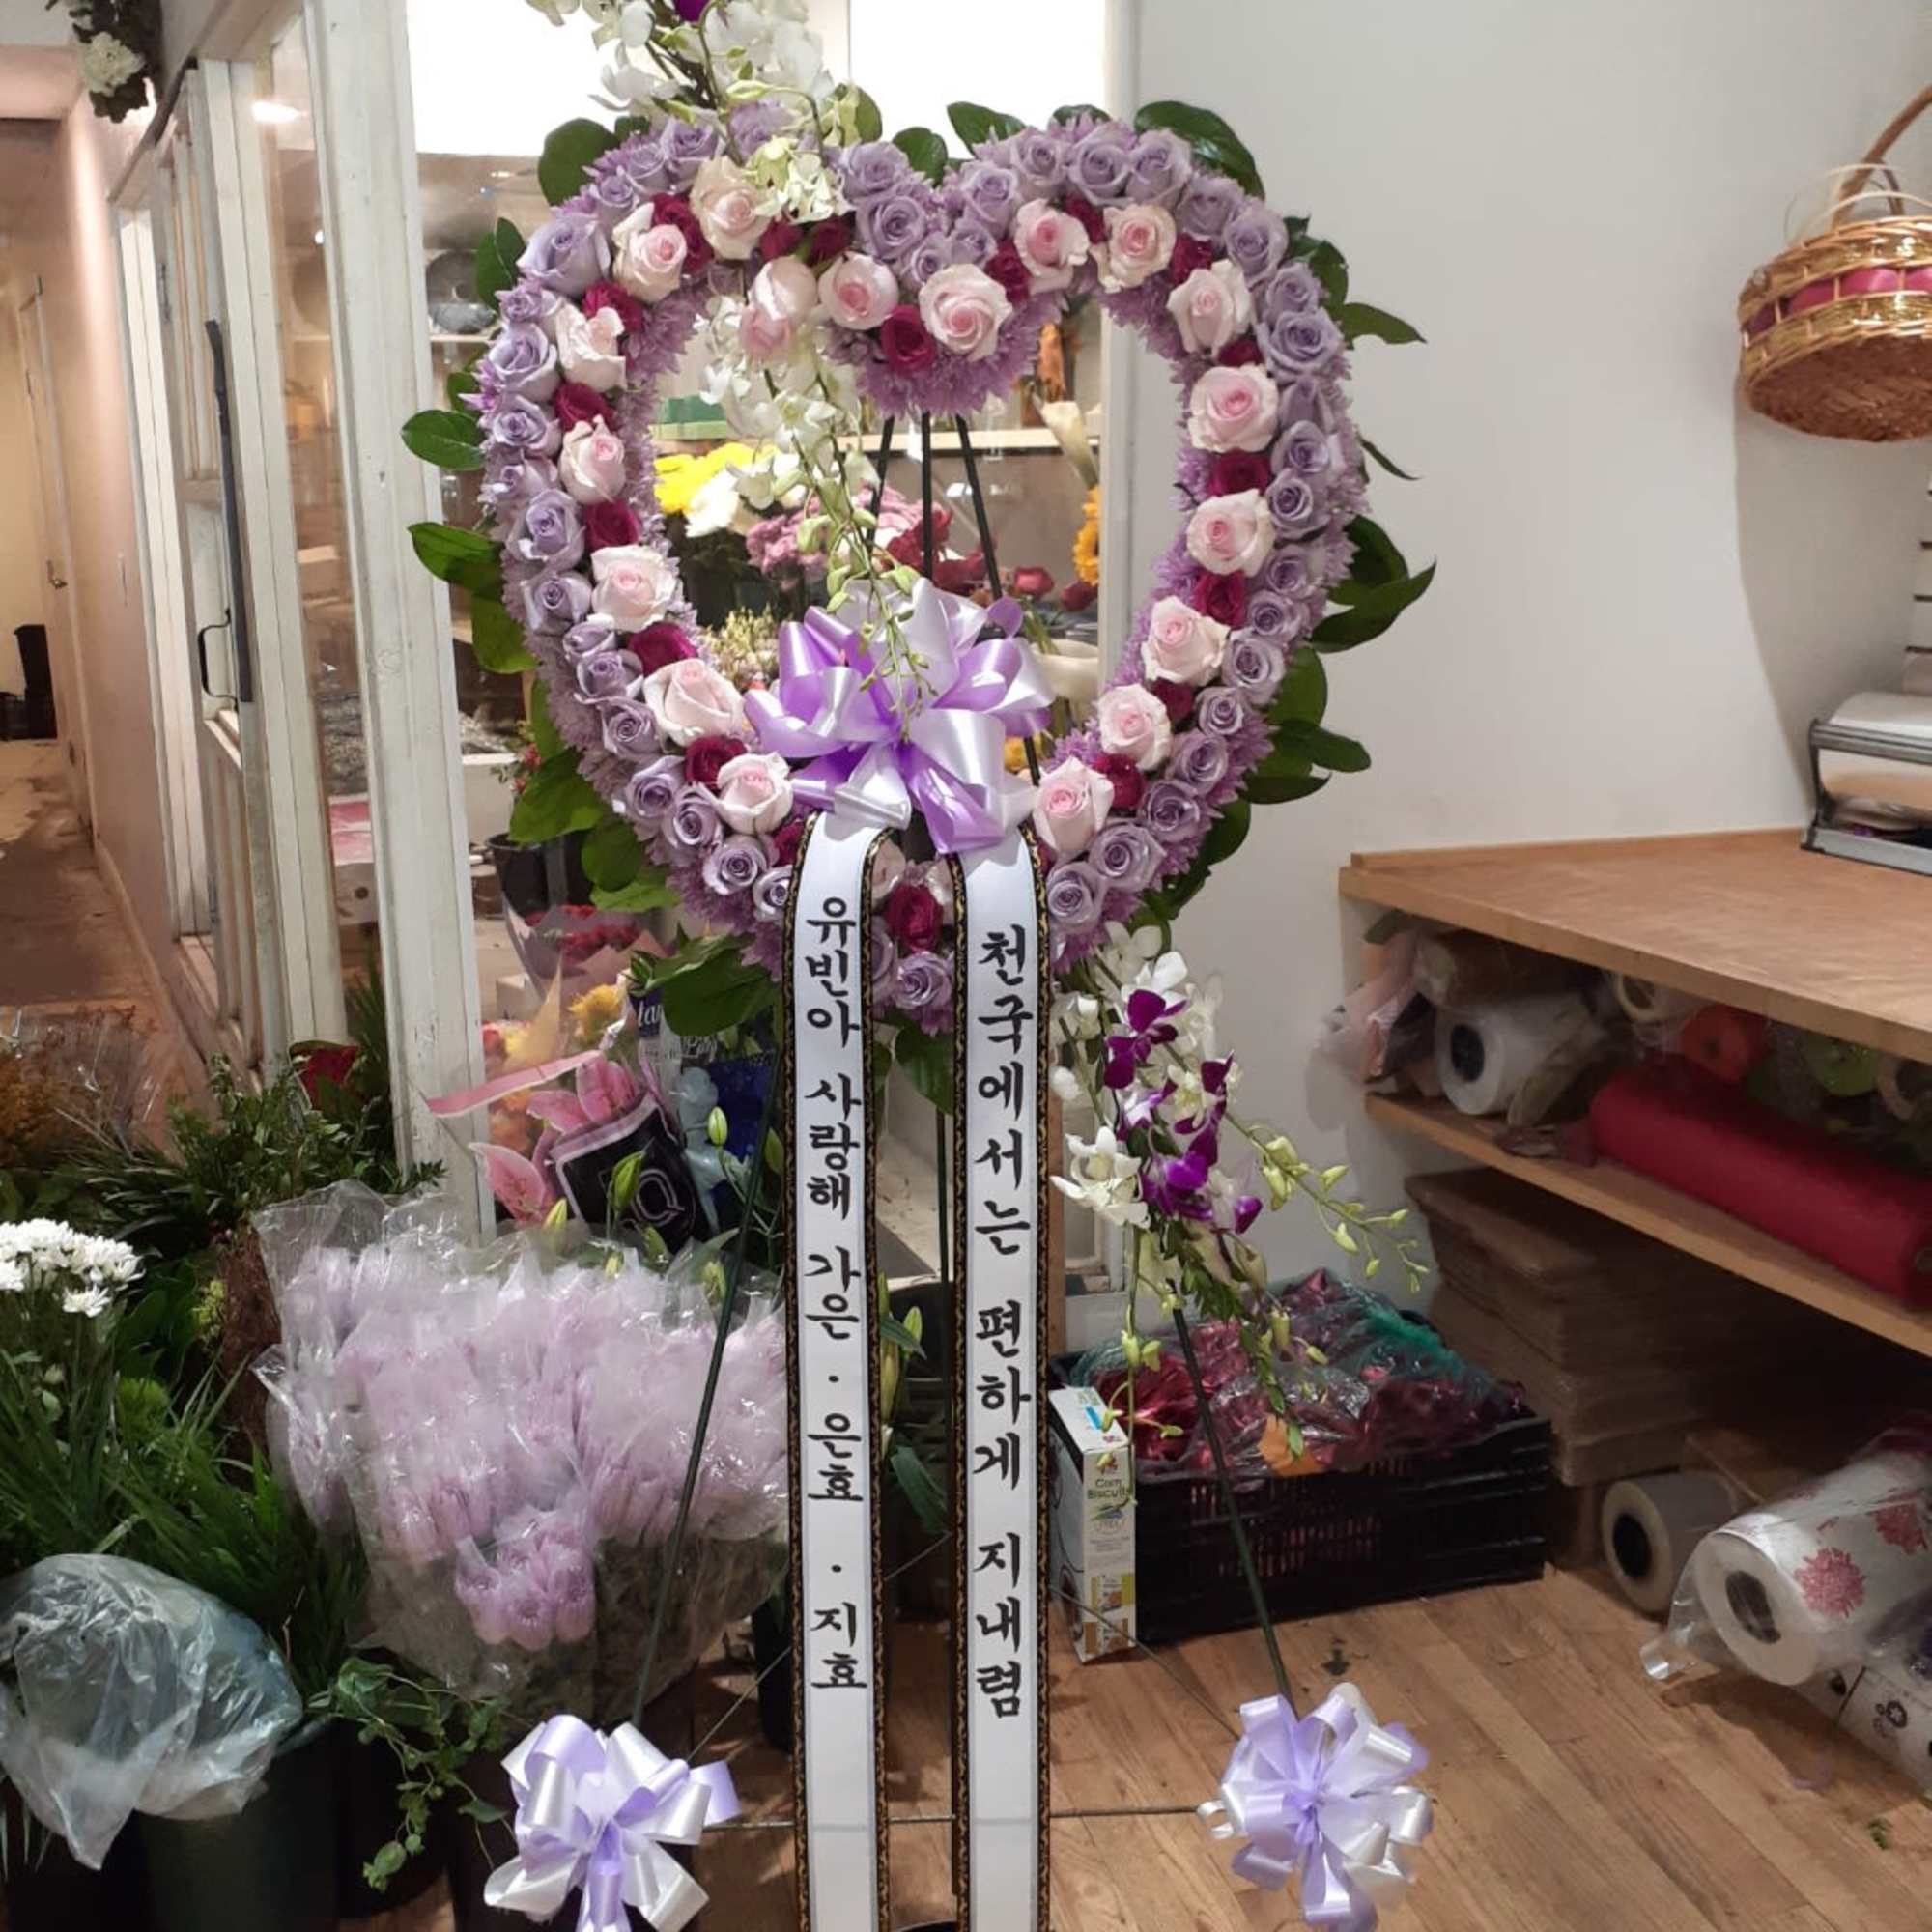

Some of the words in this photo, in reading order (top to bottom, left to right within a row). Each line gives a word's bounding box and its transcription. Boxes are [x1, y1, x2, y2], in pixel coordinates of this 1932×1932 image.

[806, 896, 860, 1048] 유빈아
[805, 1072, 862, 1221] 사랑해
[976, 923, 1034, 1257] 천국에서는
[805, 1245, 861, 1341] 가은
[807, 1412, 863, 1502] 은효
[974, 1299, 1032, 1492] 편하게
[810, 1601, 867, 1690] 지효
[973, 1532, 1022, 1719] 지내렴
